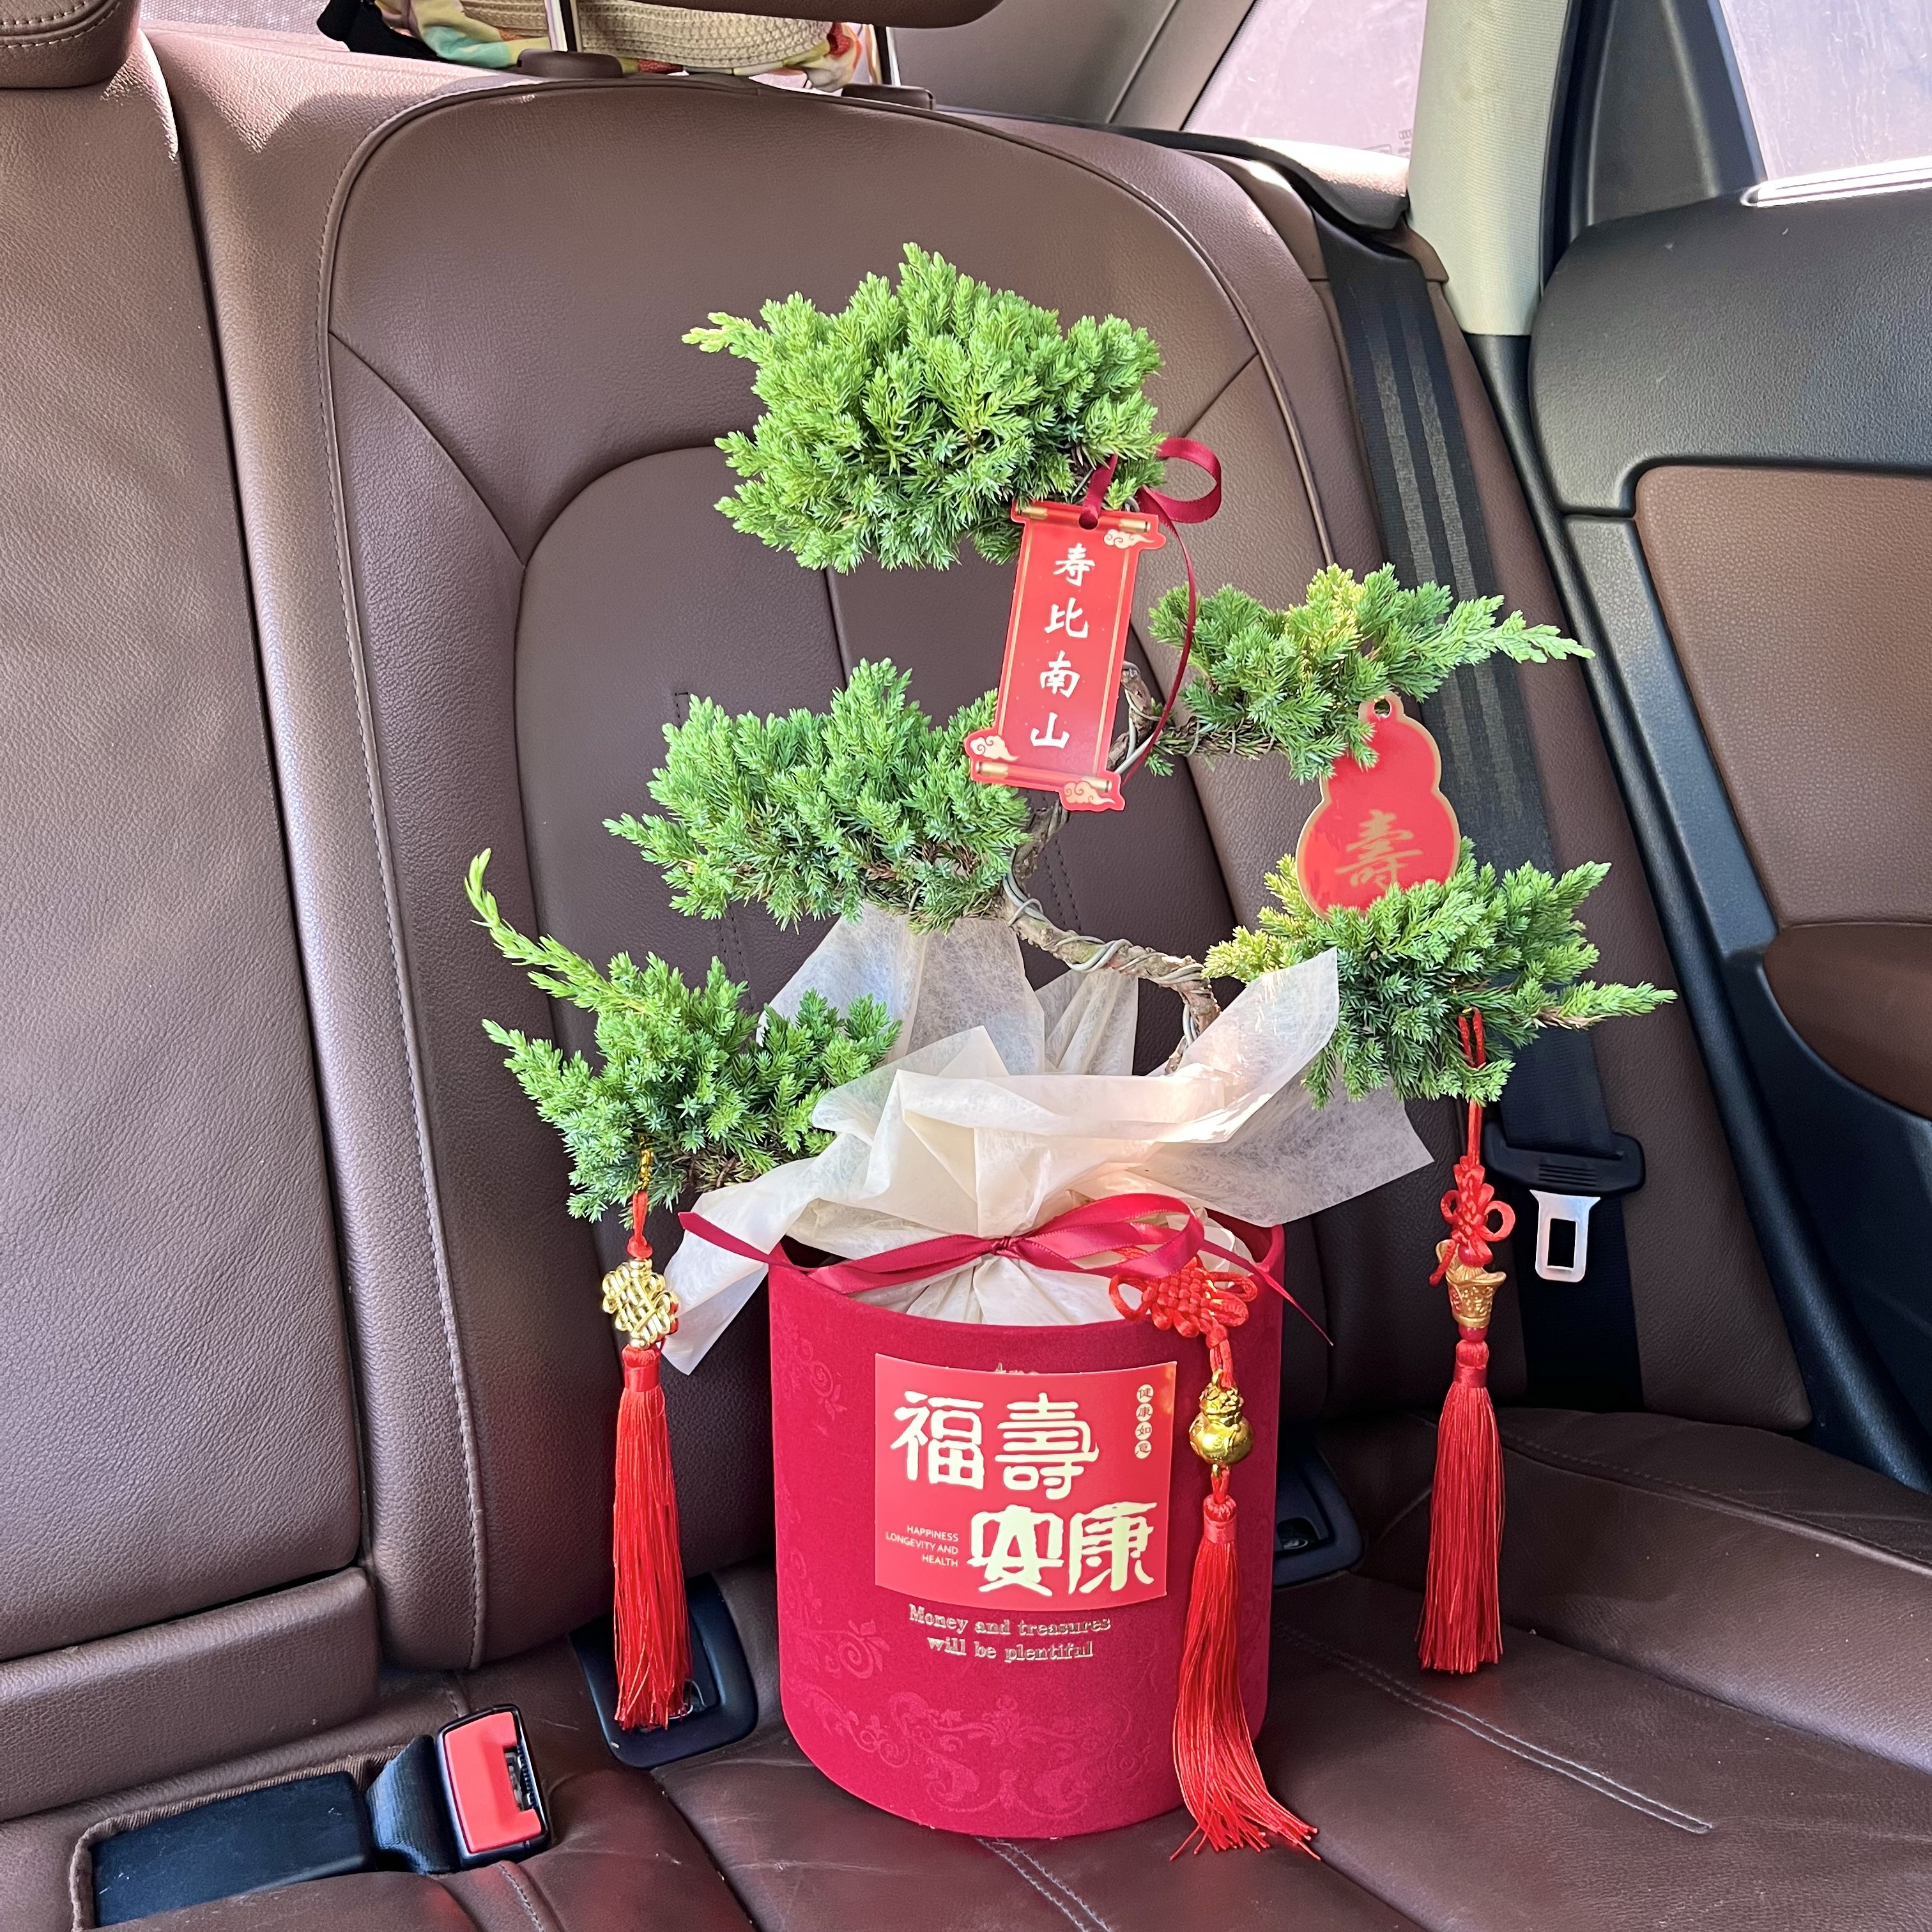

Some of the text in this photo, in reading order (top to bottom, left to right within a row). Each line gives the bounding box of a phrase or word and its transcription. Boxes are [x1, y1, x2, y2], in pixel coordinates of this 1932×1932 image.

[1031, 542, 1095, 749] 寿比南山
[891, 1390, 1100, 1500] 福壽
[885, 1531, 958, 1554] LONGEVITY AND
[907, 1524, 959, 1542] HAPPINESS
[922, 1553, 958, 1567] HEALTH
[967, 1501, 1158, 1597] 安康
[908, 1603, 1112, 1636] Money and treasures
[926, 1636, 1094, 1664] will be plentiful
